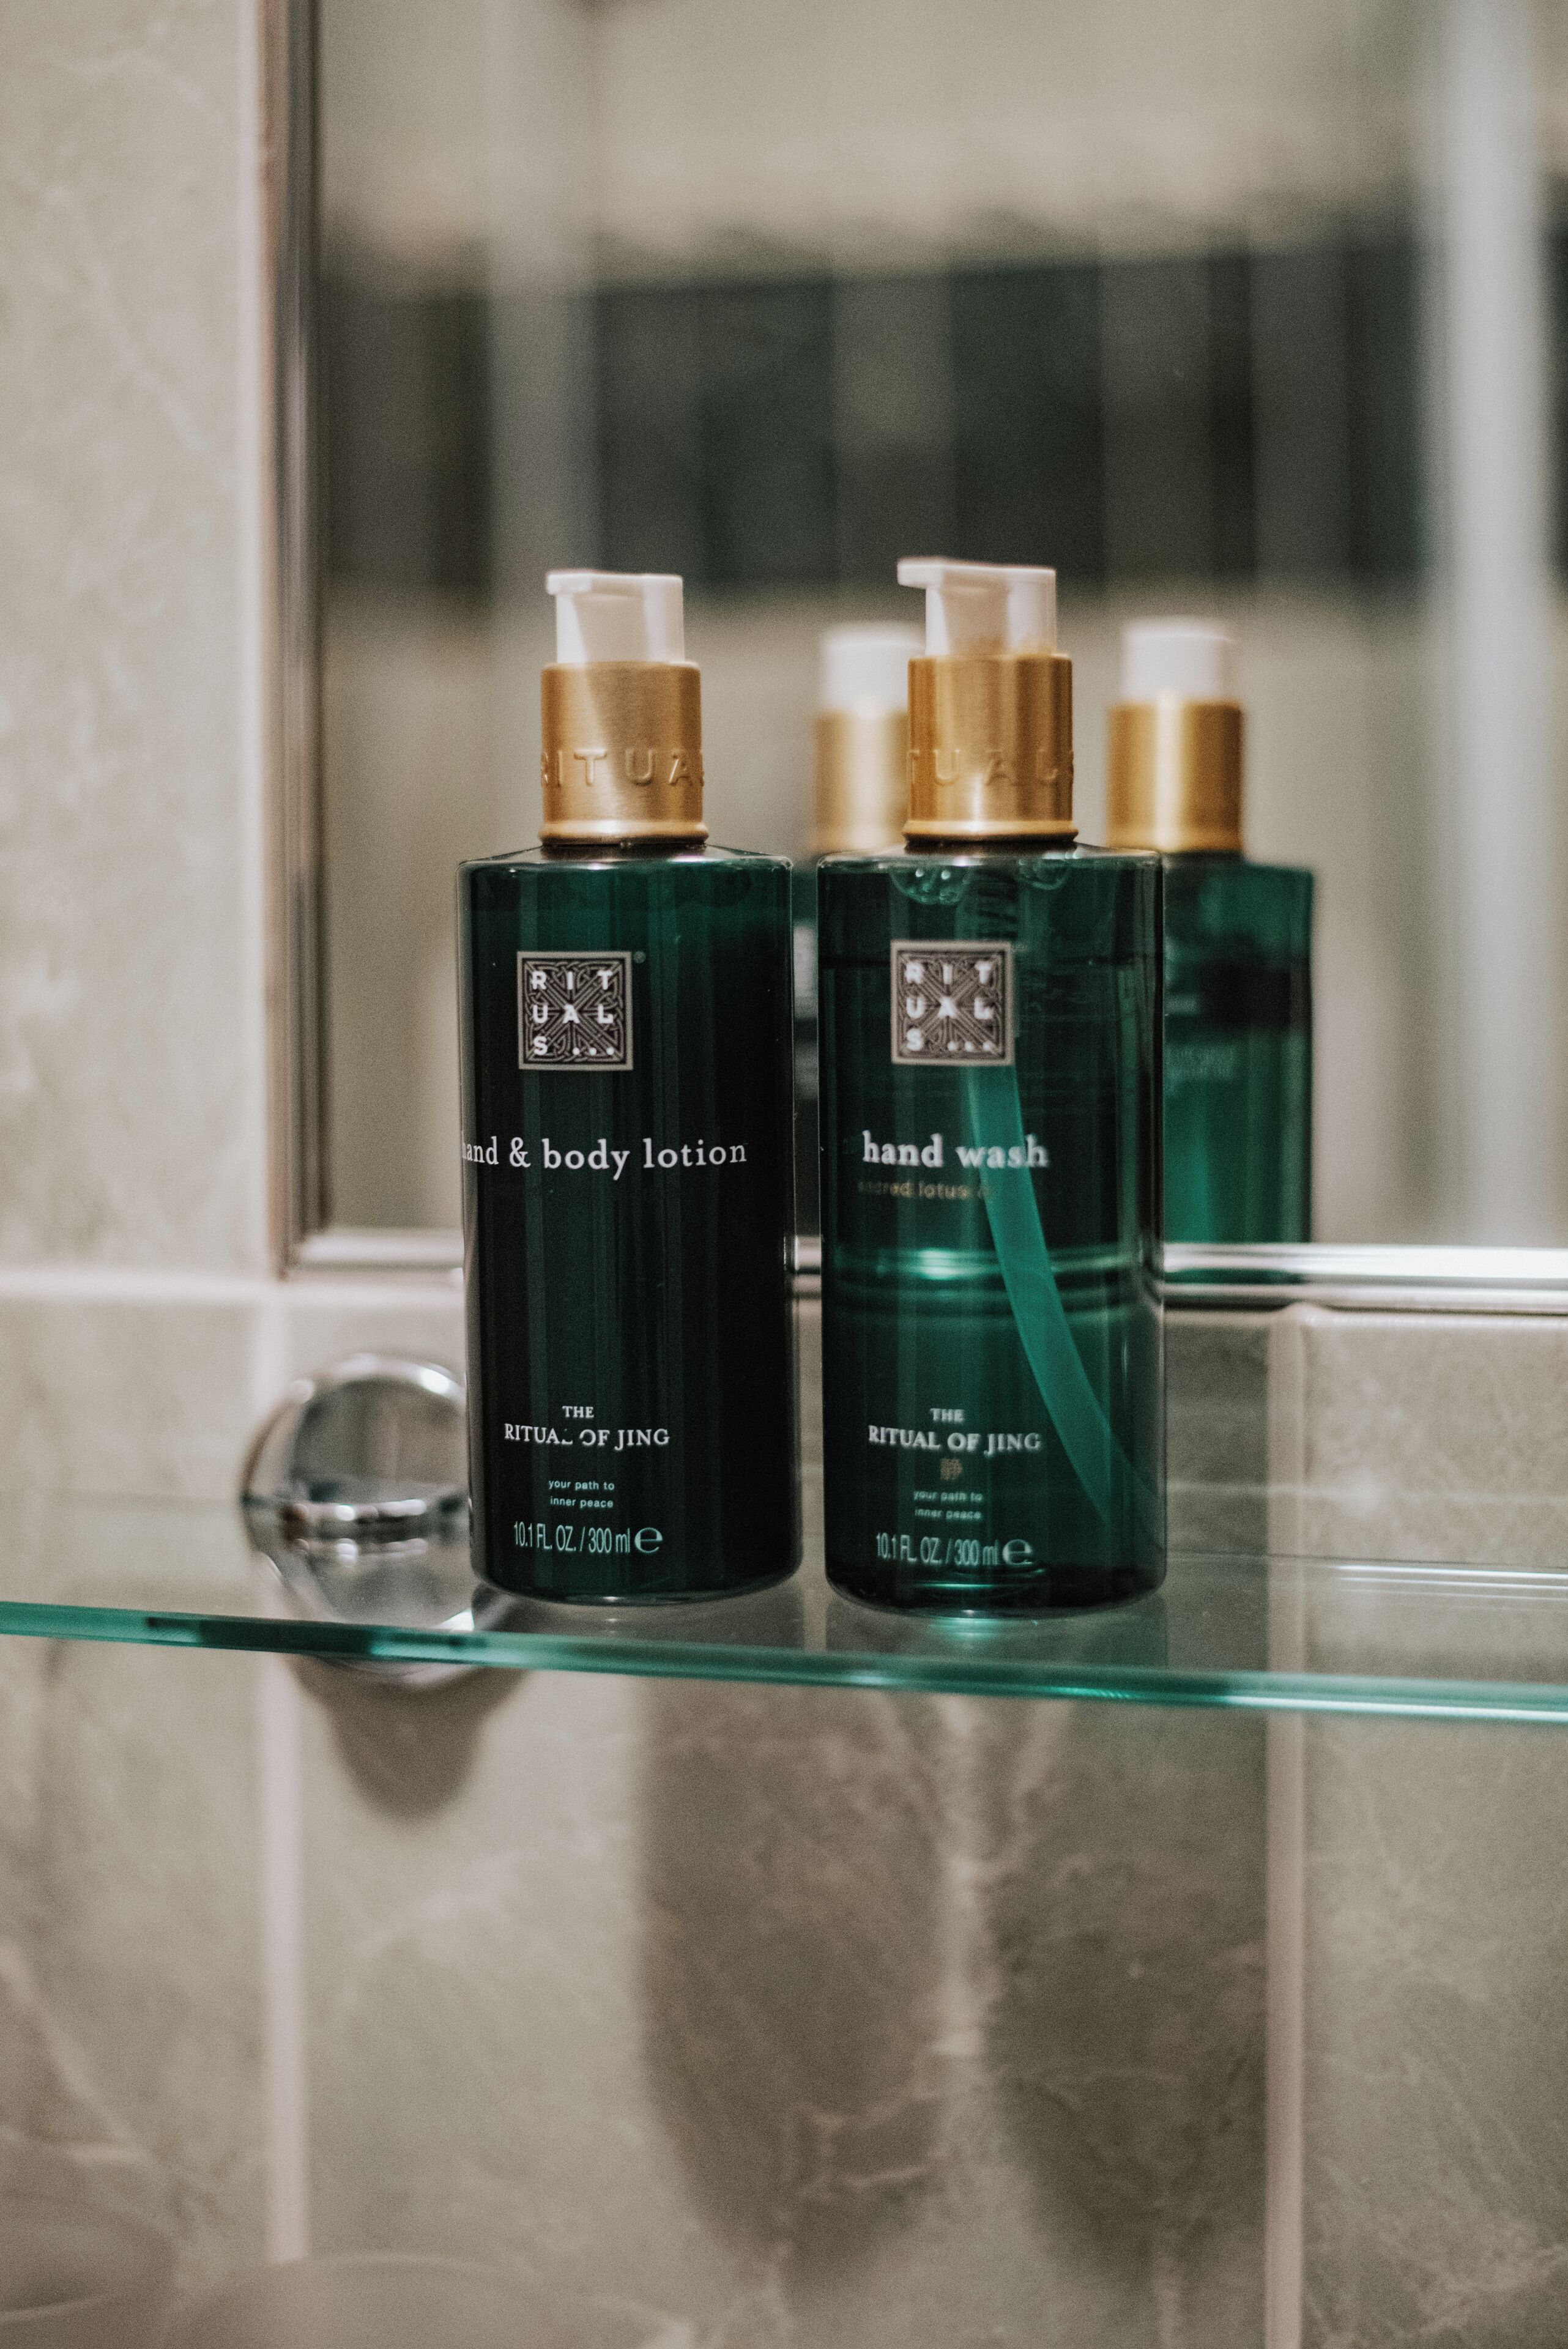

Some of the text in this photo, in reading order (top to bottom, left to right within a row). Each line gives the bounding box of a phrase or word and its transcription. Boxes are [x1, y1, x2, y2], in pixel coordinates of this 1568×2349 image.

[509, 1137, 531, 1168] &
[541, 1138, 630, 1181] body
[642, 1138, 748, 1168] lotion
[861, 1130, 1050, 1168] hand wash
[562, 1406, 595, 1419] THE
[930, 1408, 966, 1424] THE
[579, 1428, 611, 1447] OF
[614, 1428, 671, 1452] JING
[868, 1425, 1042, 1458] RITUAL OF JING
[548, 1480, 615, 1491] your path to
[550, 1496, 614, 1509] inner peace
[513, 1521, 533, 1548] 10.1
[555, 1524, 577, 1552] OZ.
[579, 1526, 586, 1552] /
[588, 1527, 612, 1553] 300
[615, 1527, 631, 1554] ml
[876, 1532, 897, 1560] 10.1
[945, 1537, 953, 1565] /
[954, 1538, 981, 1567] 300
[982, 1538, 1000, 1566] ml
